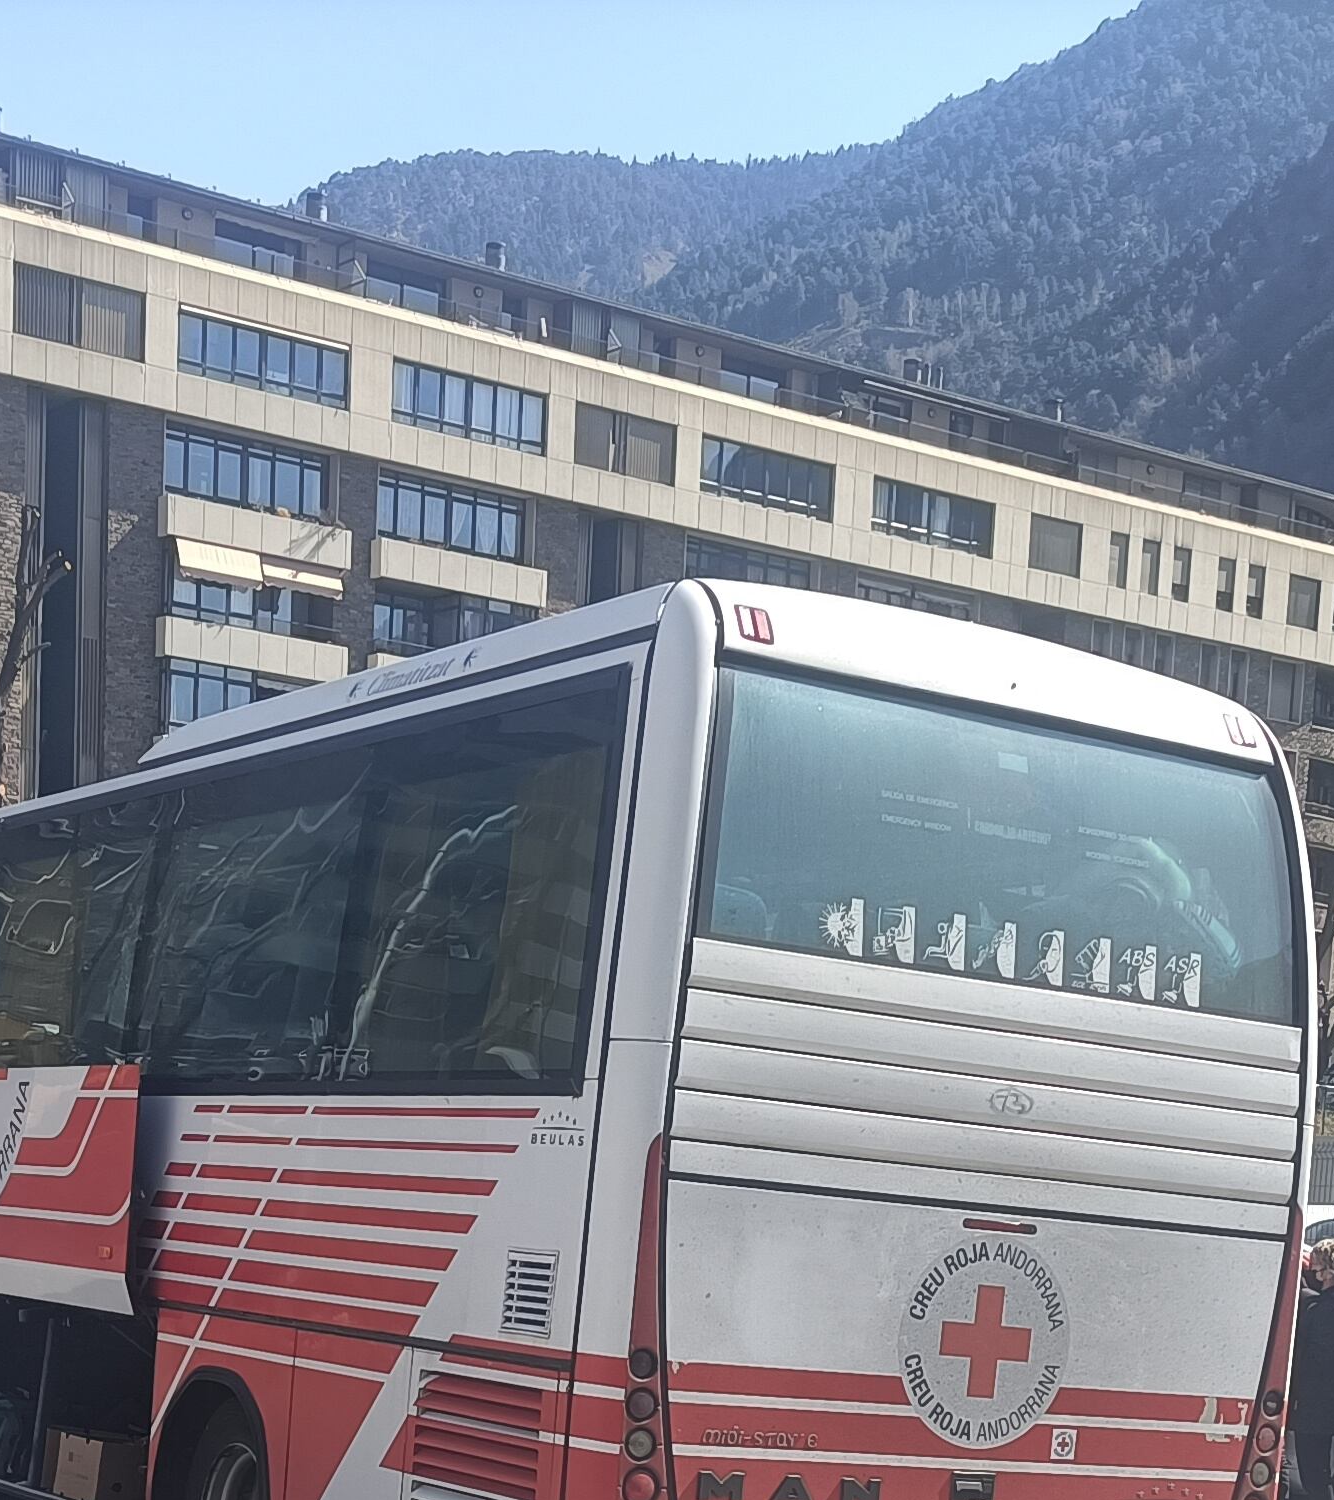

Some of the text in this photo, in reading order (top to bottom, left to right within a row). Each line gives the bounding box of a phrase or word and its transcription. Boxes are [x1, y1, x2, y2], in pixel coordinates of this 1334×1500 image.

[1118, 948, 1155, 967] ABS
[1164, 955, 1199, 976] ASR
[530, 1133, 585, 1147] BEULAS
[909, 1241, 1065, 1333] CREU ROJA ANDORRANA
[904, 1354, 1061, 1442] CREU ROJA ANDORRANA
